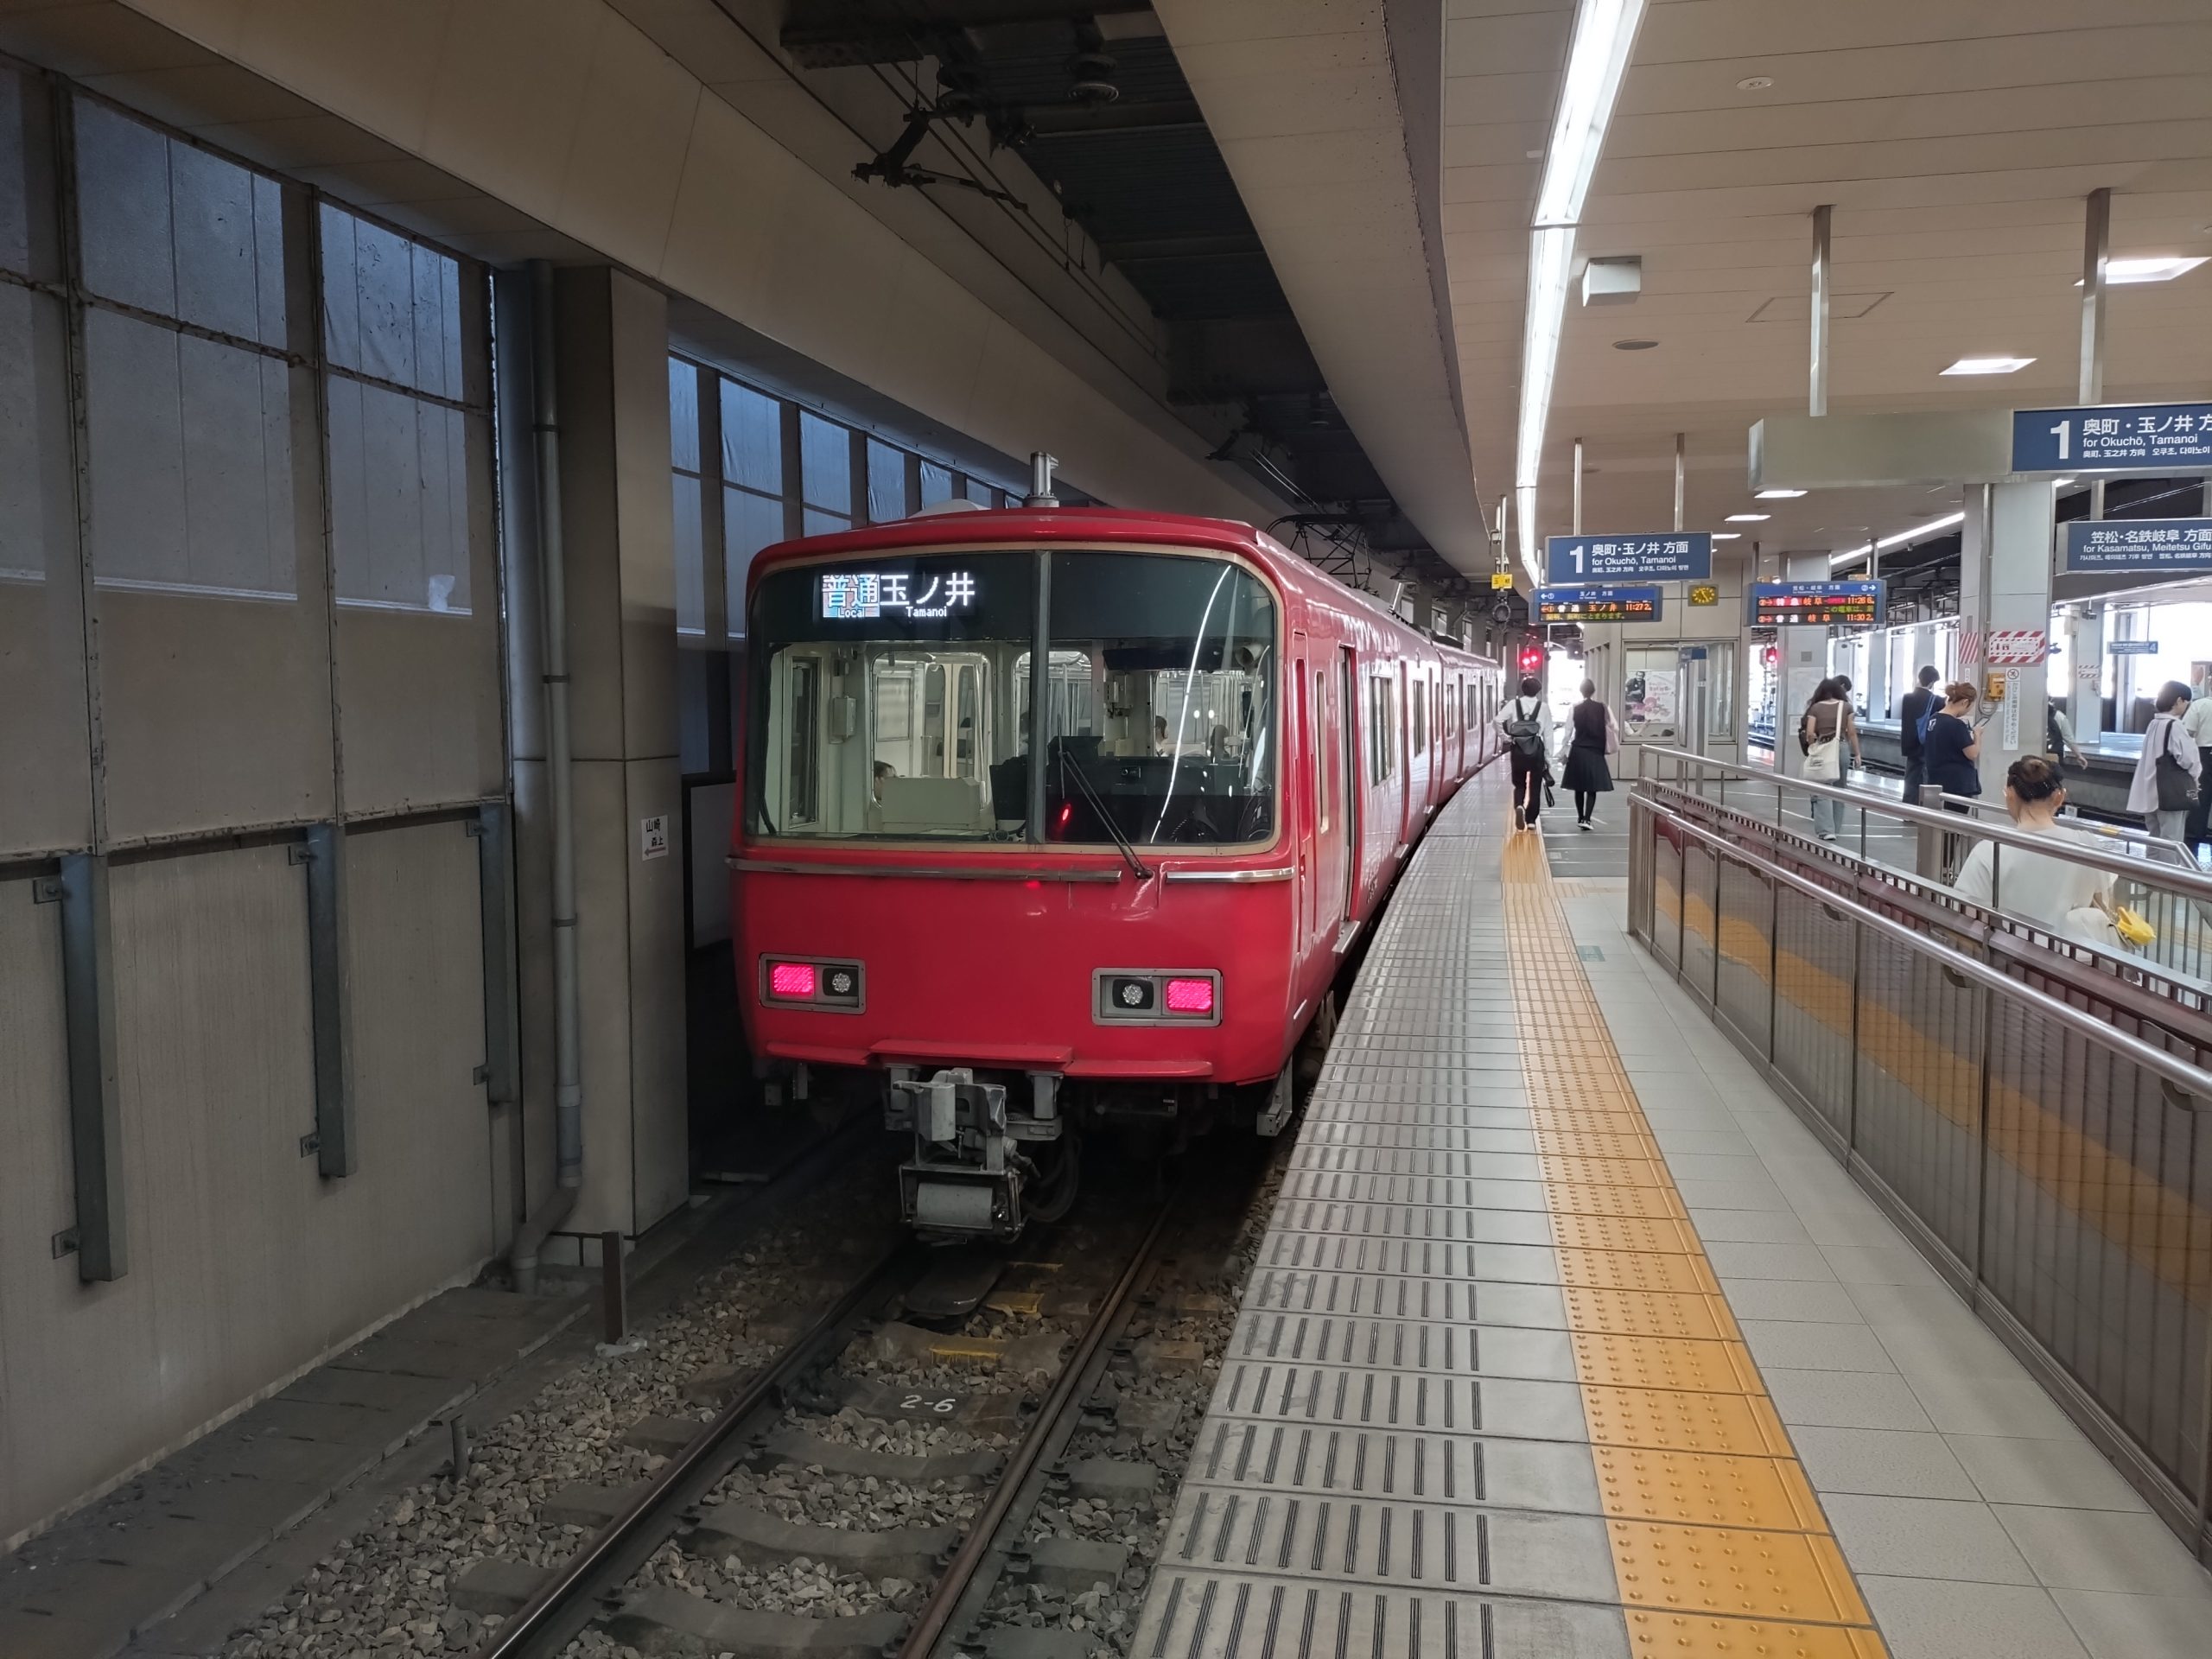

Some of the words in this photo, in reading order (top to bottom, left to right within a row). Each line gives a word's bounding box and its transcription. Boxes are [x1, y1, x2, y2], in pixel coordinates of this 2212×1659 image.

[2050, 421, 2069, 459] 1
[2082, 415, 2193, 435] 奥町・玉ノ井
[2083, 438, 2097, 448] for
[2150, 434, 2198, 445] Tamanoi
[2183, 529, 2211, 542] 方面
[2083, 544, 2094, 553] for
[2097, 543, 2150, 553] Kasamatsu,
[2152, 543, 2190, 551] Meitetsu
[2193, 542, 2211, 550] Gifu
[1570, 545, 1584, 574] 1
[1663, 541, 1688, 554] 方面
[823, 575, 880, 607] 普通
[880, 572, 975, 607] 玉ノ井
[837, 608, 865, 618] Local
[906, 606, 947, 617] Tamanoi
[899, 1395, 956, 1412] 2-6
